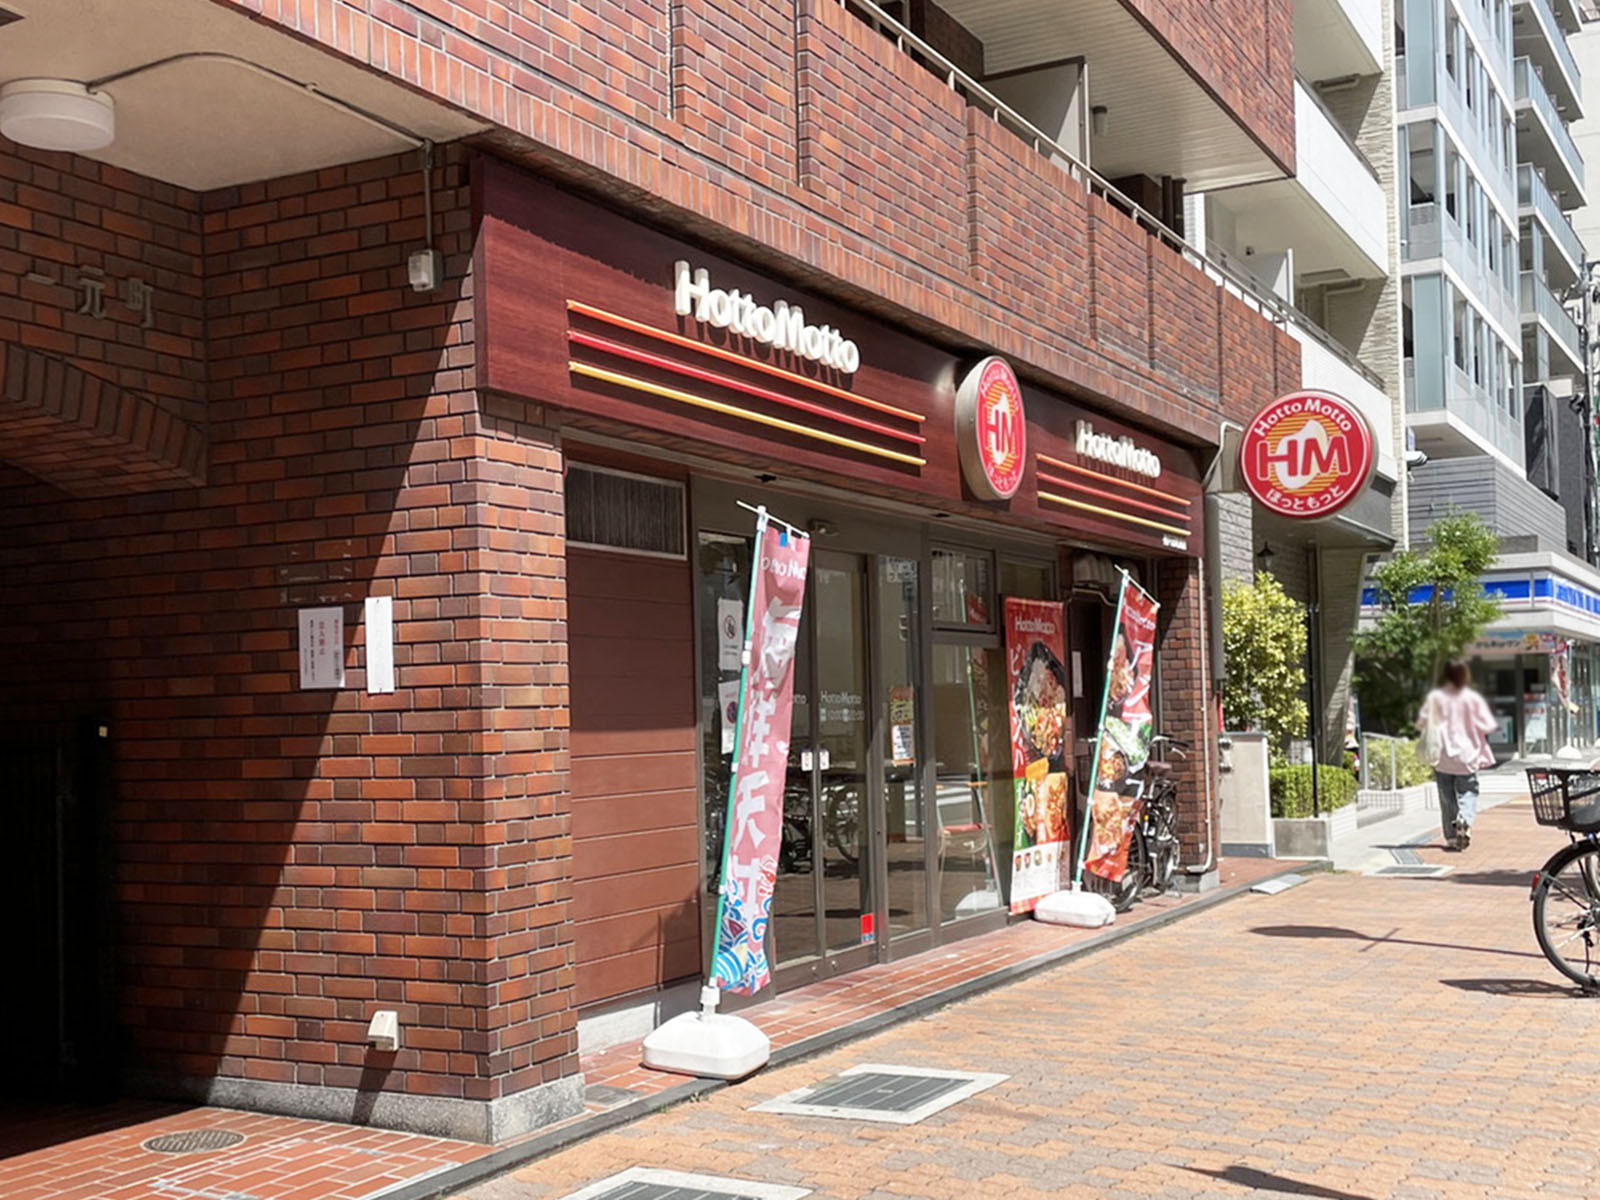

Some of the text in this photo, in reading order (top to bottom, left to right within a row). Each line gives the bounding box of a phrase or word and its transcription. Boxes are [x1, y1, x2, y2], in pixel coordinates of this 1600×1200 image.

[675, 260, 859, 374] HottoMotto
[985, 406, 1016, 456] HM
[1075, 420, 1162, 478] HottoMotto
[1256, 433, 1350, 482] HM
[1265, 484, 1344, 512] ほっともっと
